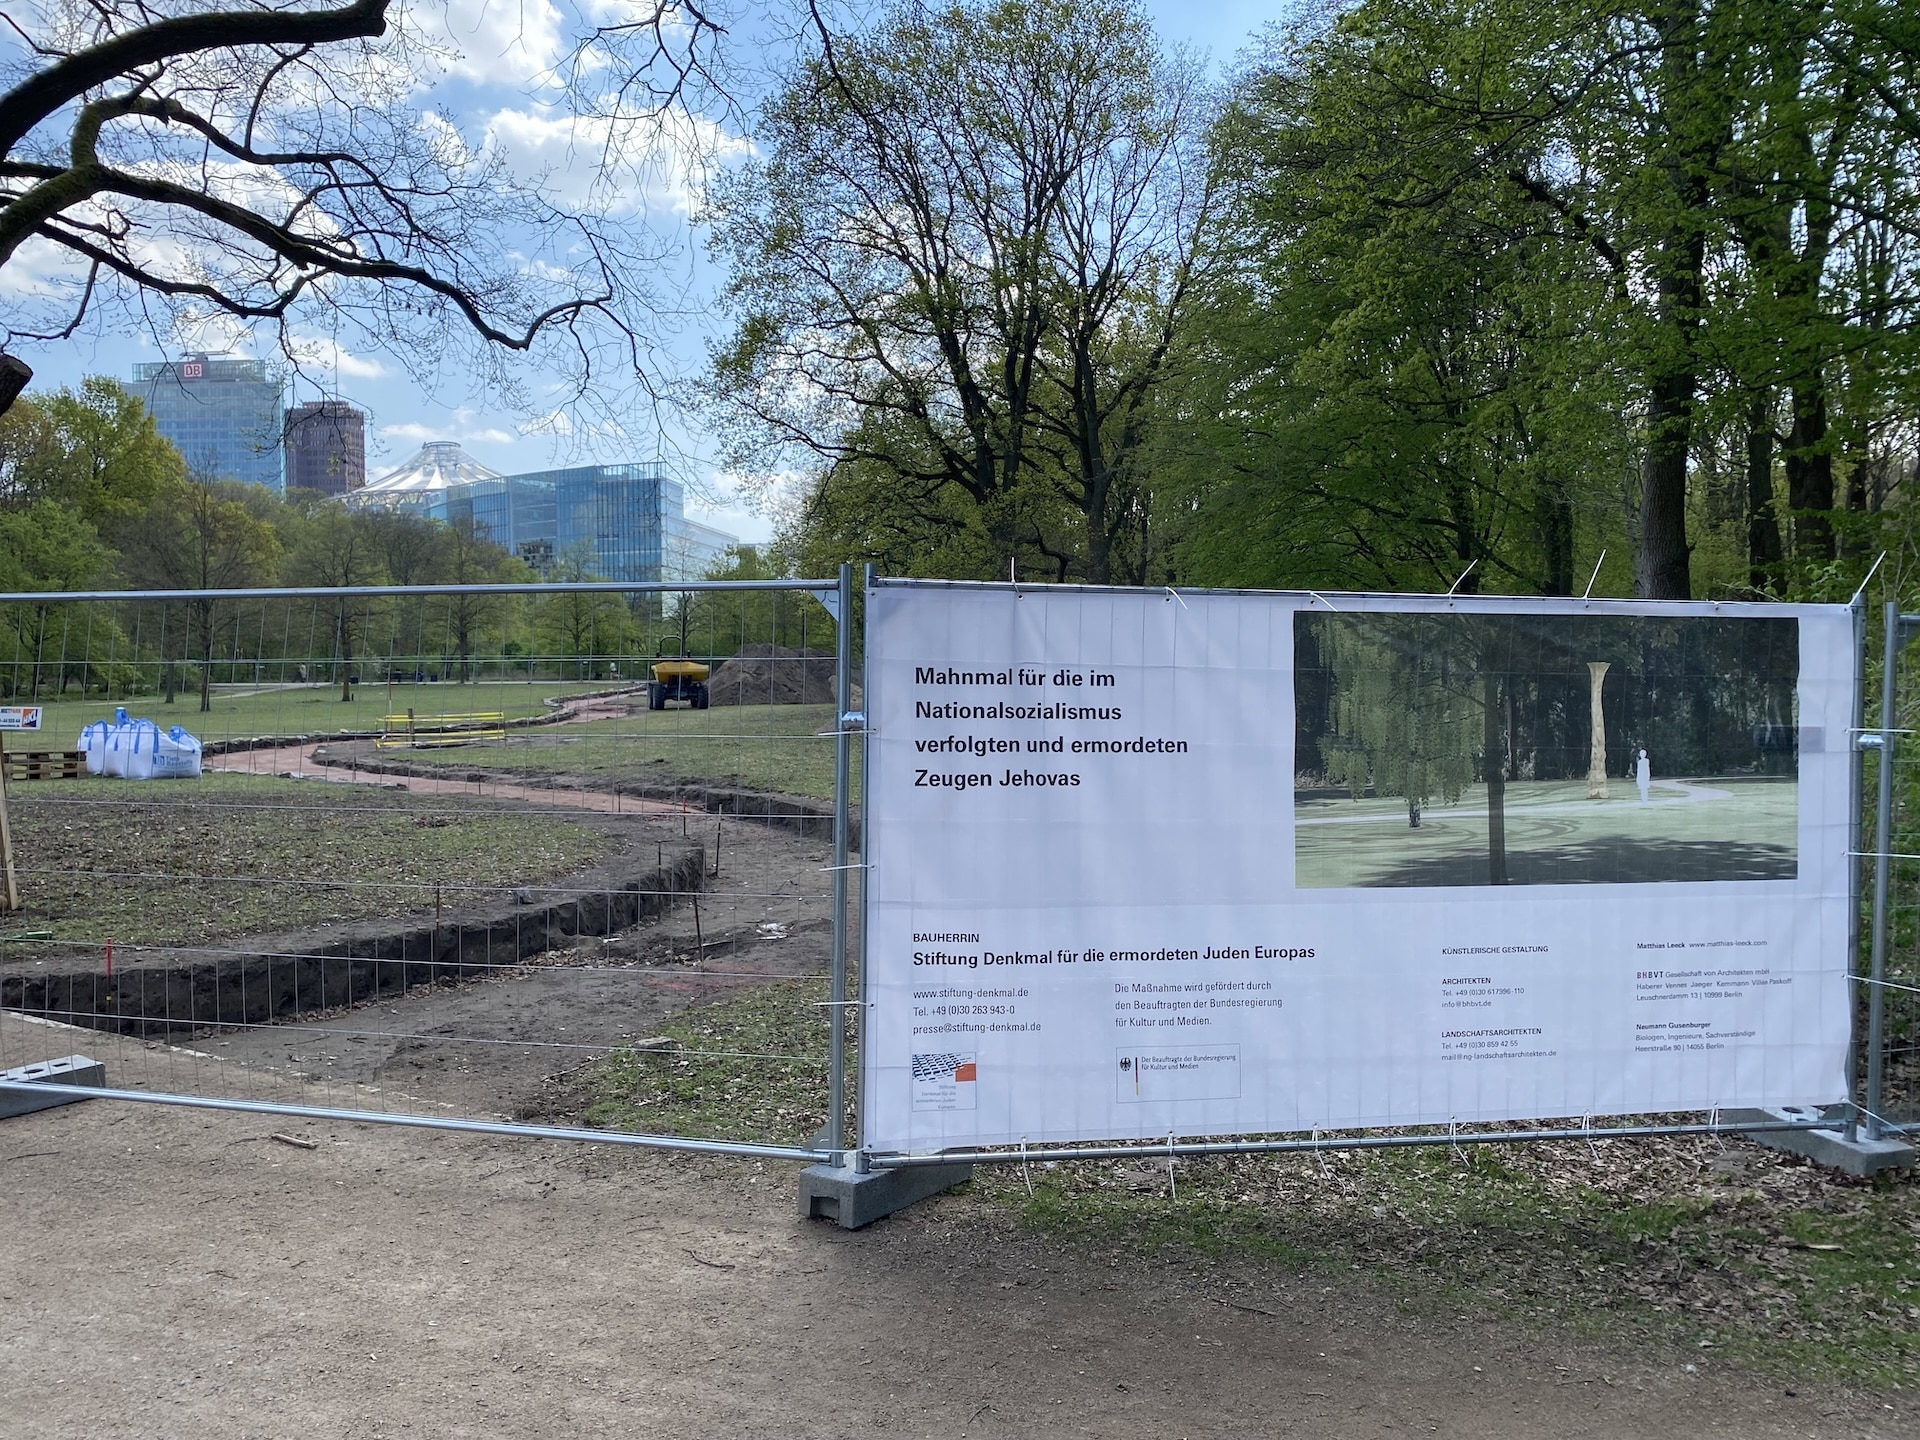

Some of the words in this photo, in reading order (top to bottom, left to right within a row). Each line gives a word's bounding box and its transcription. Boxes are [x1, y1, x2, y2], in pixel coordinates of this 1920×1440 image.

[185, 365, 201, 376] DB
[915, 667, 1013, 685] Mahnmal
[1018, 669, 1046, 686] für
[1053, 670, 1083, 687] die
[1090, 670, 1115, 687] im
[916, 701, 1122, 720] Nationalsozialismus
[915, 735, 1020, 757] verfolgten
[1027, 736, 1064, 753] und
[1071, 736, 1188, 753] ermordeten
[914, 769, 992, 790] Zeugen
[999, 770, 1081, 787] Jehovas
[913, 933, 980, 943] BAUHERRIN
[1442, 946, 1500, 955] KÜNSTLERISCHE
[1501, 945, 1549, 953] GESTALTUNG
[913, 951, 978, 969] Stiftung
[984, 950, 1052, 966] Denkmal
[1057, 949, 1078, 963] für
[1083, 948, 1105, 962] die
[1109, 948, 1198, 961] ermordeten
[1203, 946, 1249, 960] Juden
[1255, 945, 1315, 961] Europas
[1665, 970, 1702, 978] Gesellschaft
[1442, 977, 1491, 985] ARCHITEKTEN
[1690, 981, 1713, 989] Jaeger
[1114, 983, 1129, 993] Die
[1132, 982, 1182, 993] Maßnahme
[1184, 982, 1203, 992] wird
[1205, 981, 1244, 993] gefördert
[1246, 981, 1272, 991] durch
[913, 988, 1029, 1000] www.stiftung-denkmal.de
[1636, 993, 1688, 1001] Leuschnerdamm
[1115, 1001, 1131, 1010] den
[1134, 1000, 1191, 1011] Beauftragten
[1193, 999, 1207, 1009] der
[1210, 997, 1283, 1009] Bundesregierung
[913, 1007, 929, 1017] Tel.
[932, 1006, 946, 1015] +49
[948, 1005, 970, 1015] (0)30
[972, 1005, 988, 1015] 263
[990, 1005, 1015, 1015] 943-0
[1115, 1017, 1127, 1027] für
[1129, 1017, 1155, 1027] Kultur
[1158, 1017, 1174, 1026] und
[1177, 1016, 1212, 1026] Medien.
[1668, 1021, 1711, 1030] Gusenburger
[913, 1022, 1041, 1036] presse@stiftung-denkmal.de
[1442, 1028, 1542, 1038] LANDSCHAFTSARCHITEKTEN
[1636, 1034, 1666, 1042] Biologen,
[1705, 1030, 1756, 1039] Sachverständige
[1635, 1044, 1672, 1052] Heerstraße
